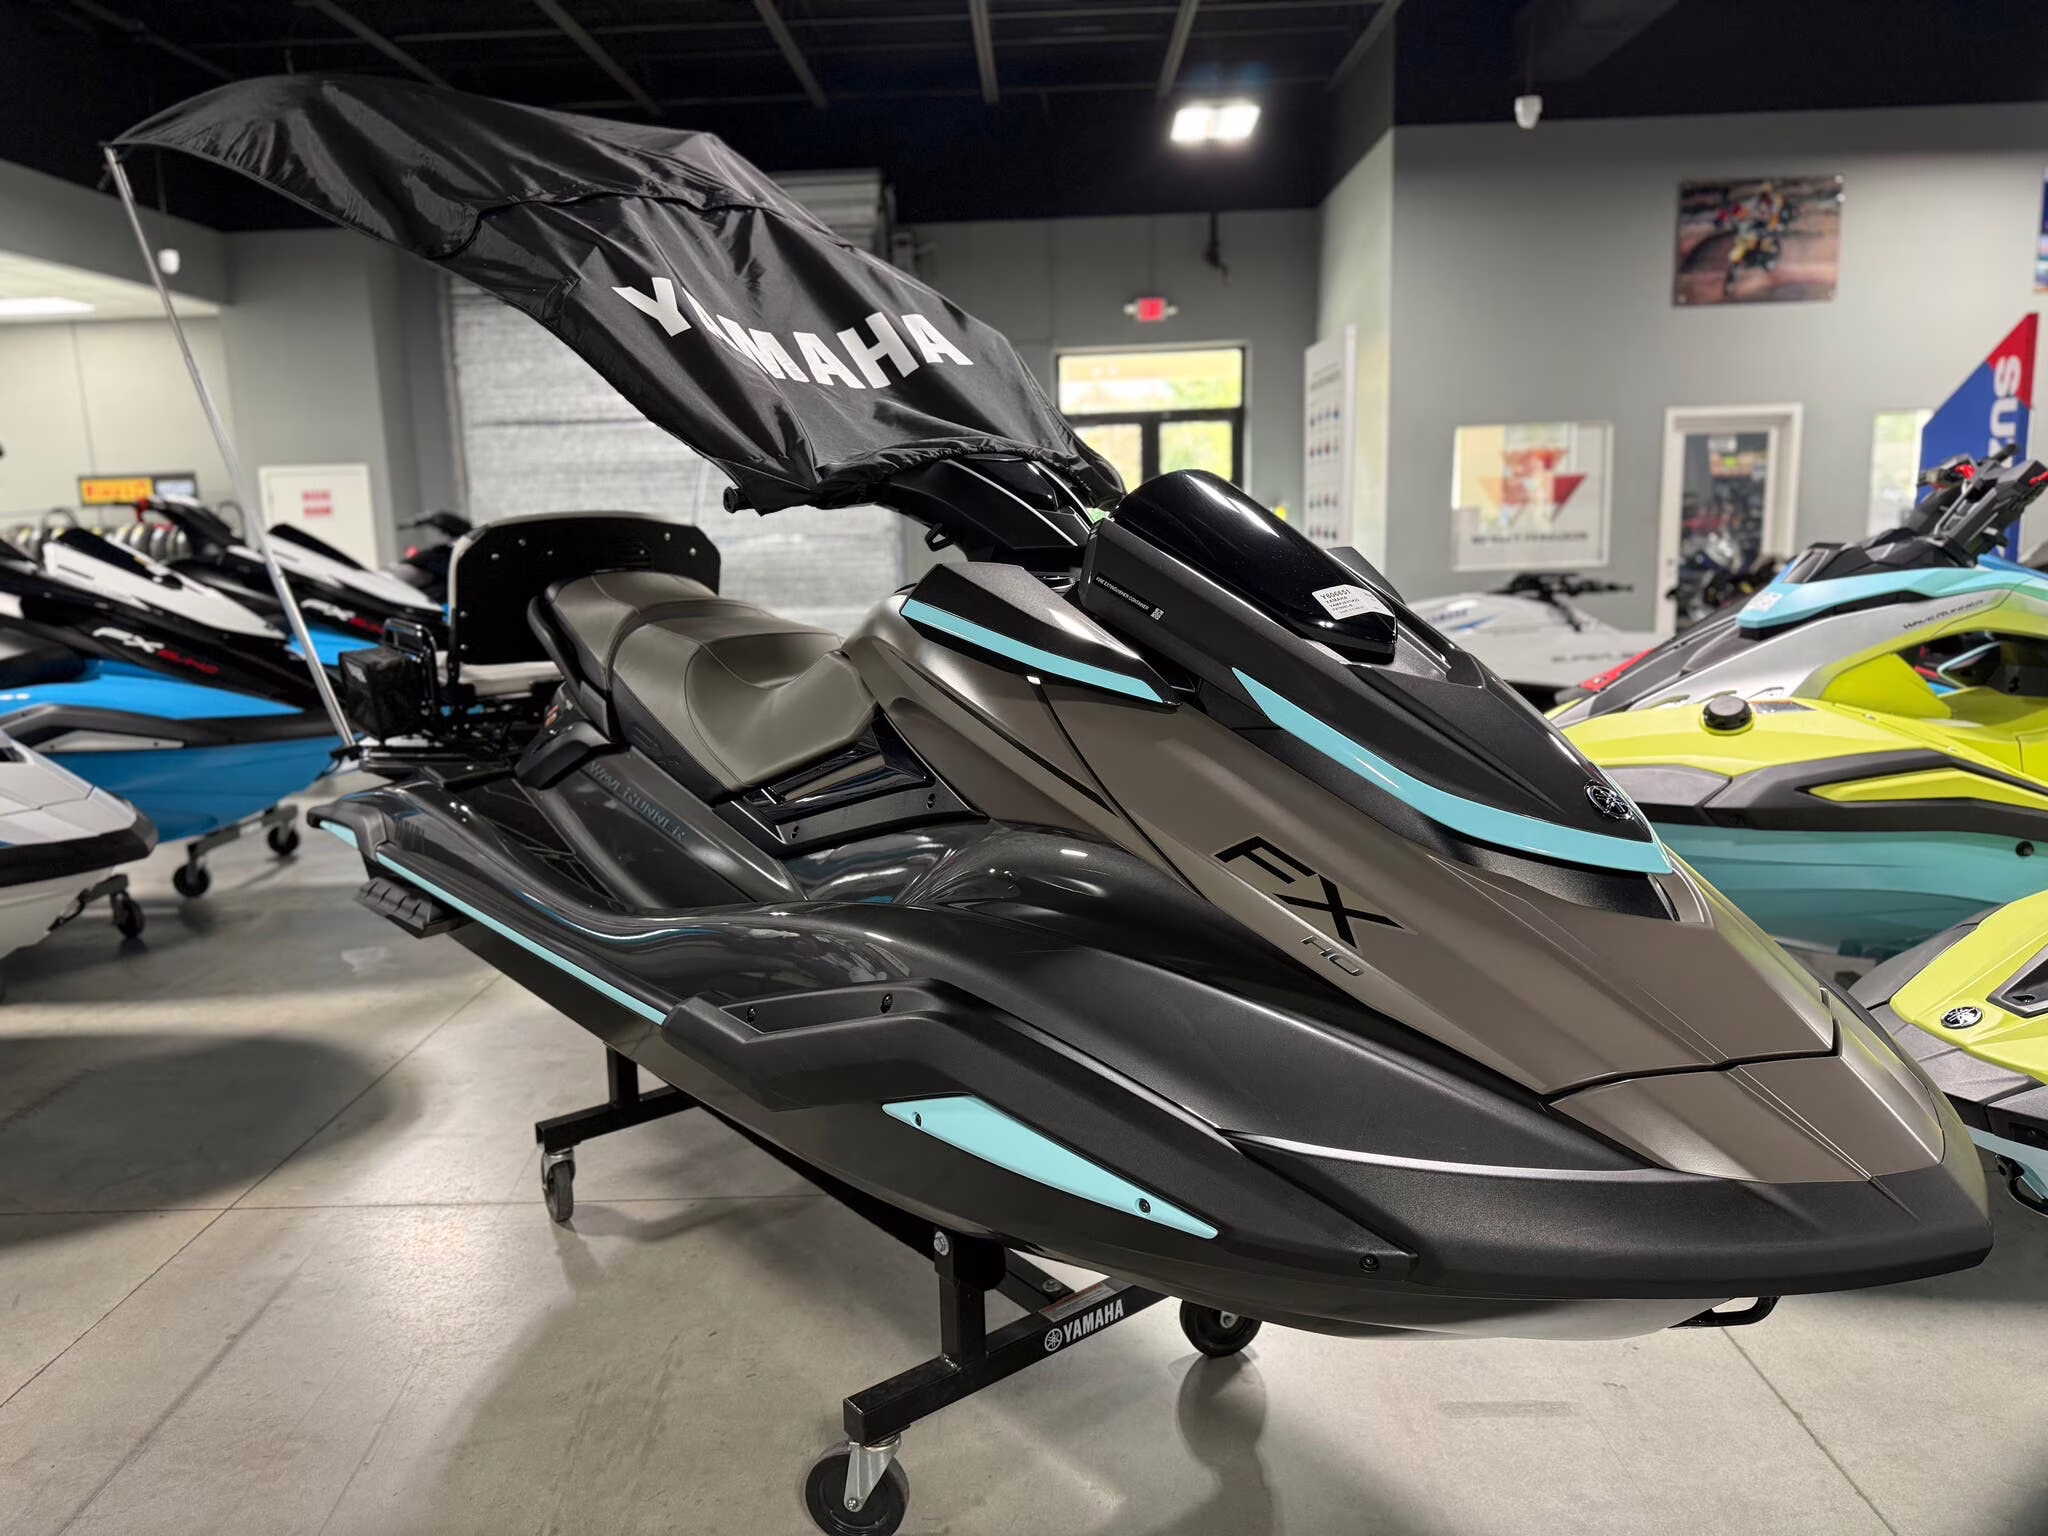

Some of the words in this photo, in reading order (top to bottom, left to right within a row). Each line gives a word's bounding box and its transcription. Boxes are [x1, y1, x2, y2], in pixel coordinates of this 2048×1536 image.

[611, 277, 974, 389] YAMAHA
[589, 760, 686, 840] WAVERUNNER
[1213, 835, 1405, 950] FX
[1062, 1298, 1124, 1343] YAMAHA
